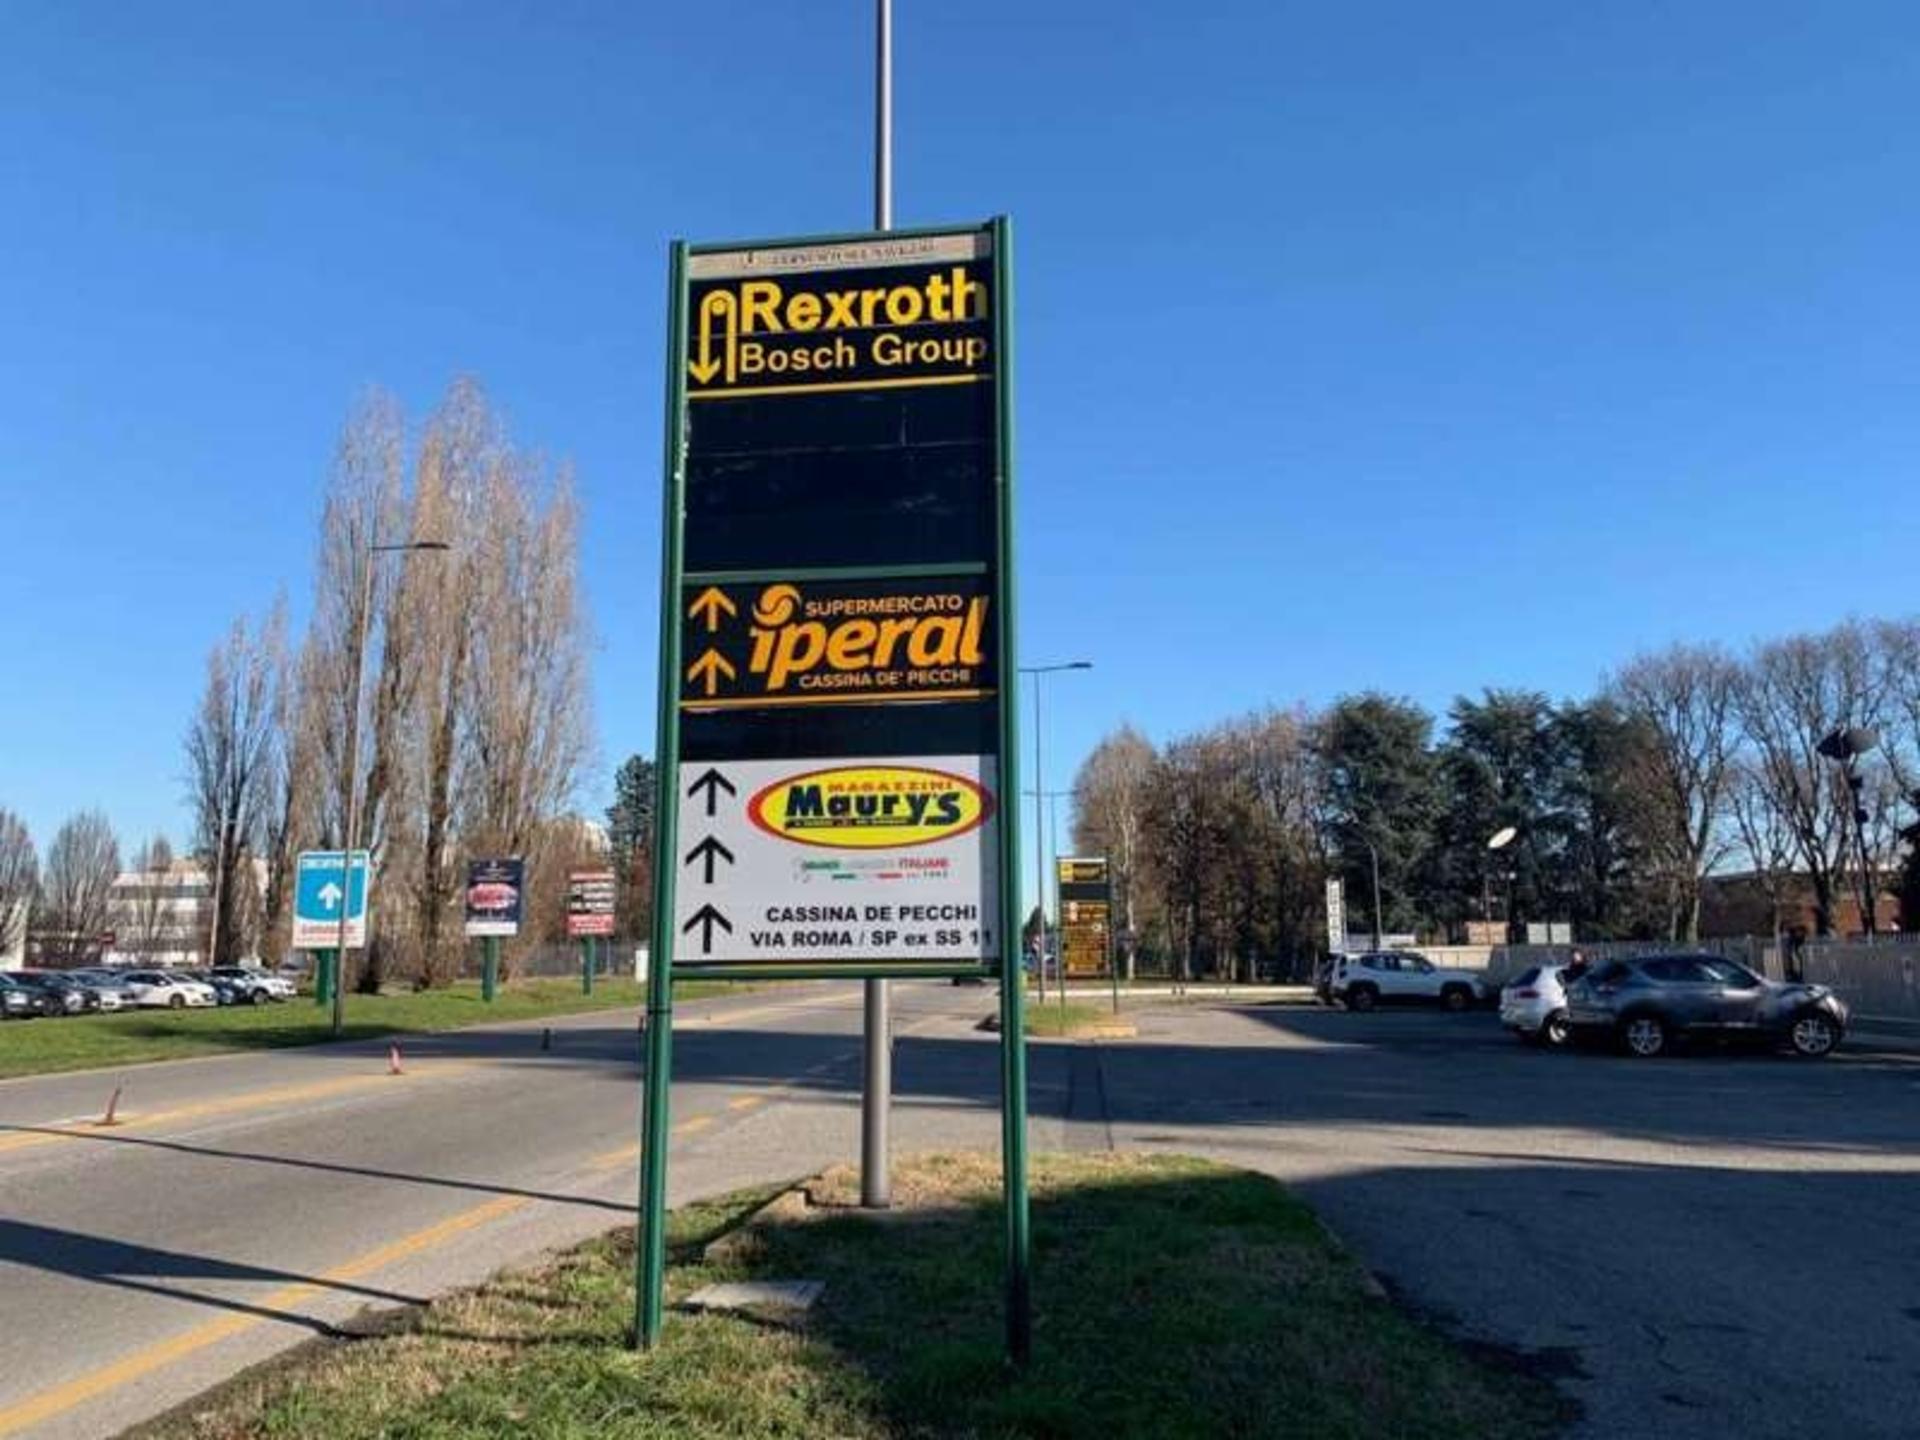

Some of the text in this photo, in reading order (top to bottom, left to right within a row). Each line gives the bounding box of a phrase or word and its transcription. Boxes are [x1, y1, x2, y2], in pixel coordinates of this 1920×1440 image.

[741, 267, 987, 334] Rexroth
[741, 333, 988, 373] Bosch Group
[805, 595, 963, 617] SUPERMERCATO
[750, 596, 987, 691] iperal
[800, 673, 872, 689] CASSINA
[908, 669, 971, 685] PECCHI
[785, 784, 962, 827] Maury's
[766, 904, 977, 923] CASSINA DE PECCHI
[750, 932, 786, 948] VIA
[792, 930, 853, 947] ROMA
[871, 930, 898, 947] SP
[904, 932, 928, 947] ex
[935, 930, 962, 946] SS
[969, 930, 992, 946] 11
